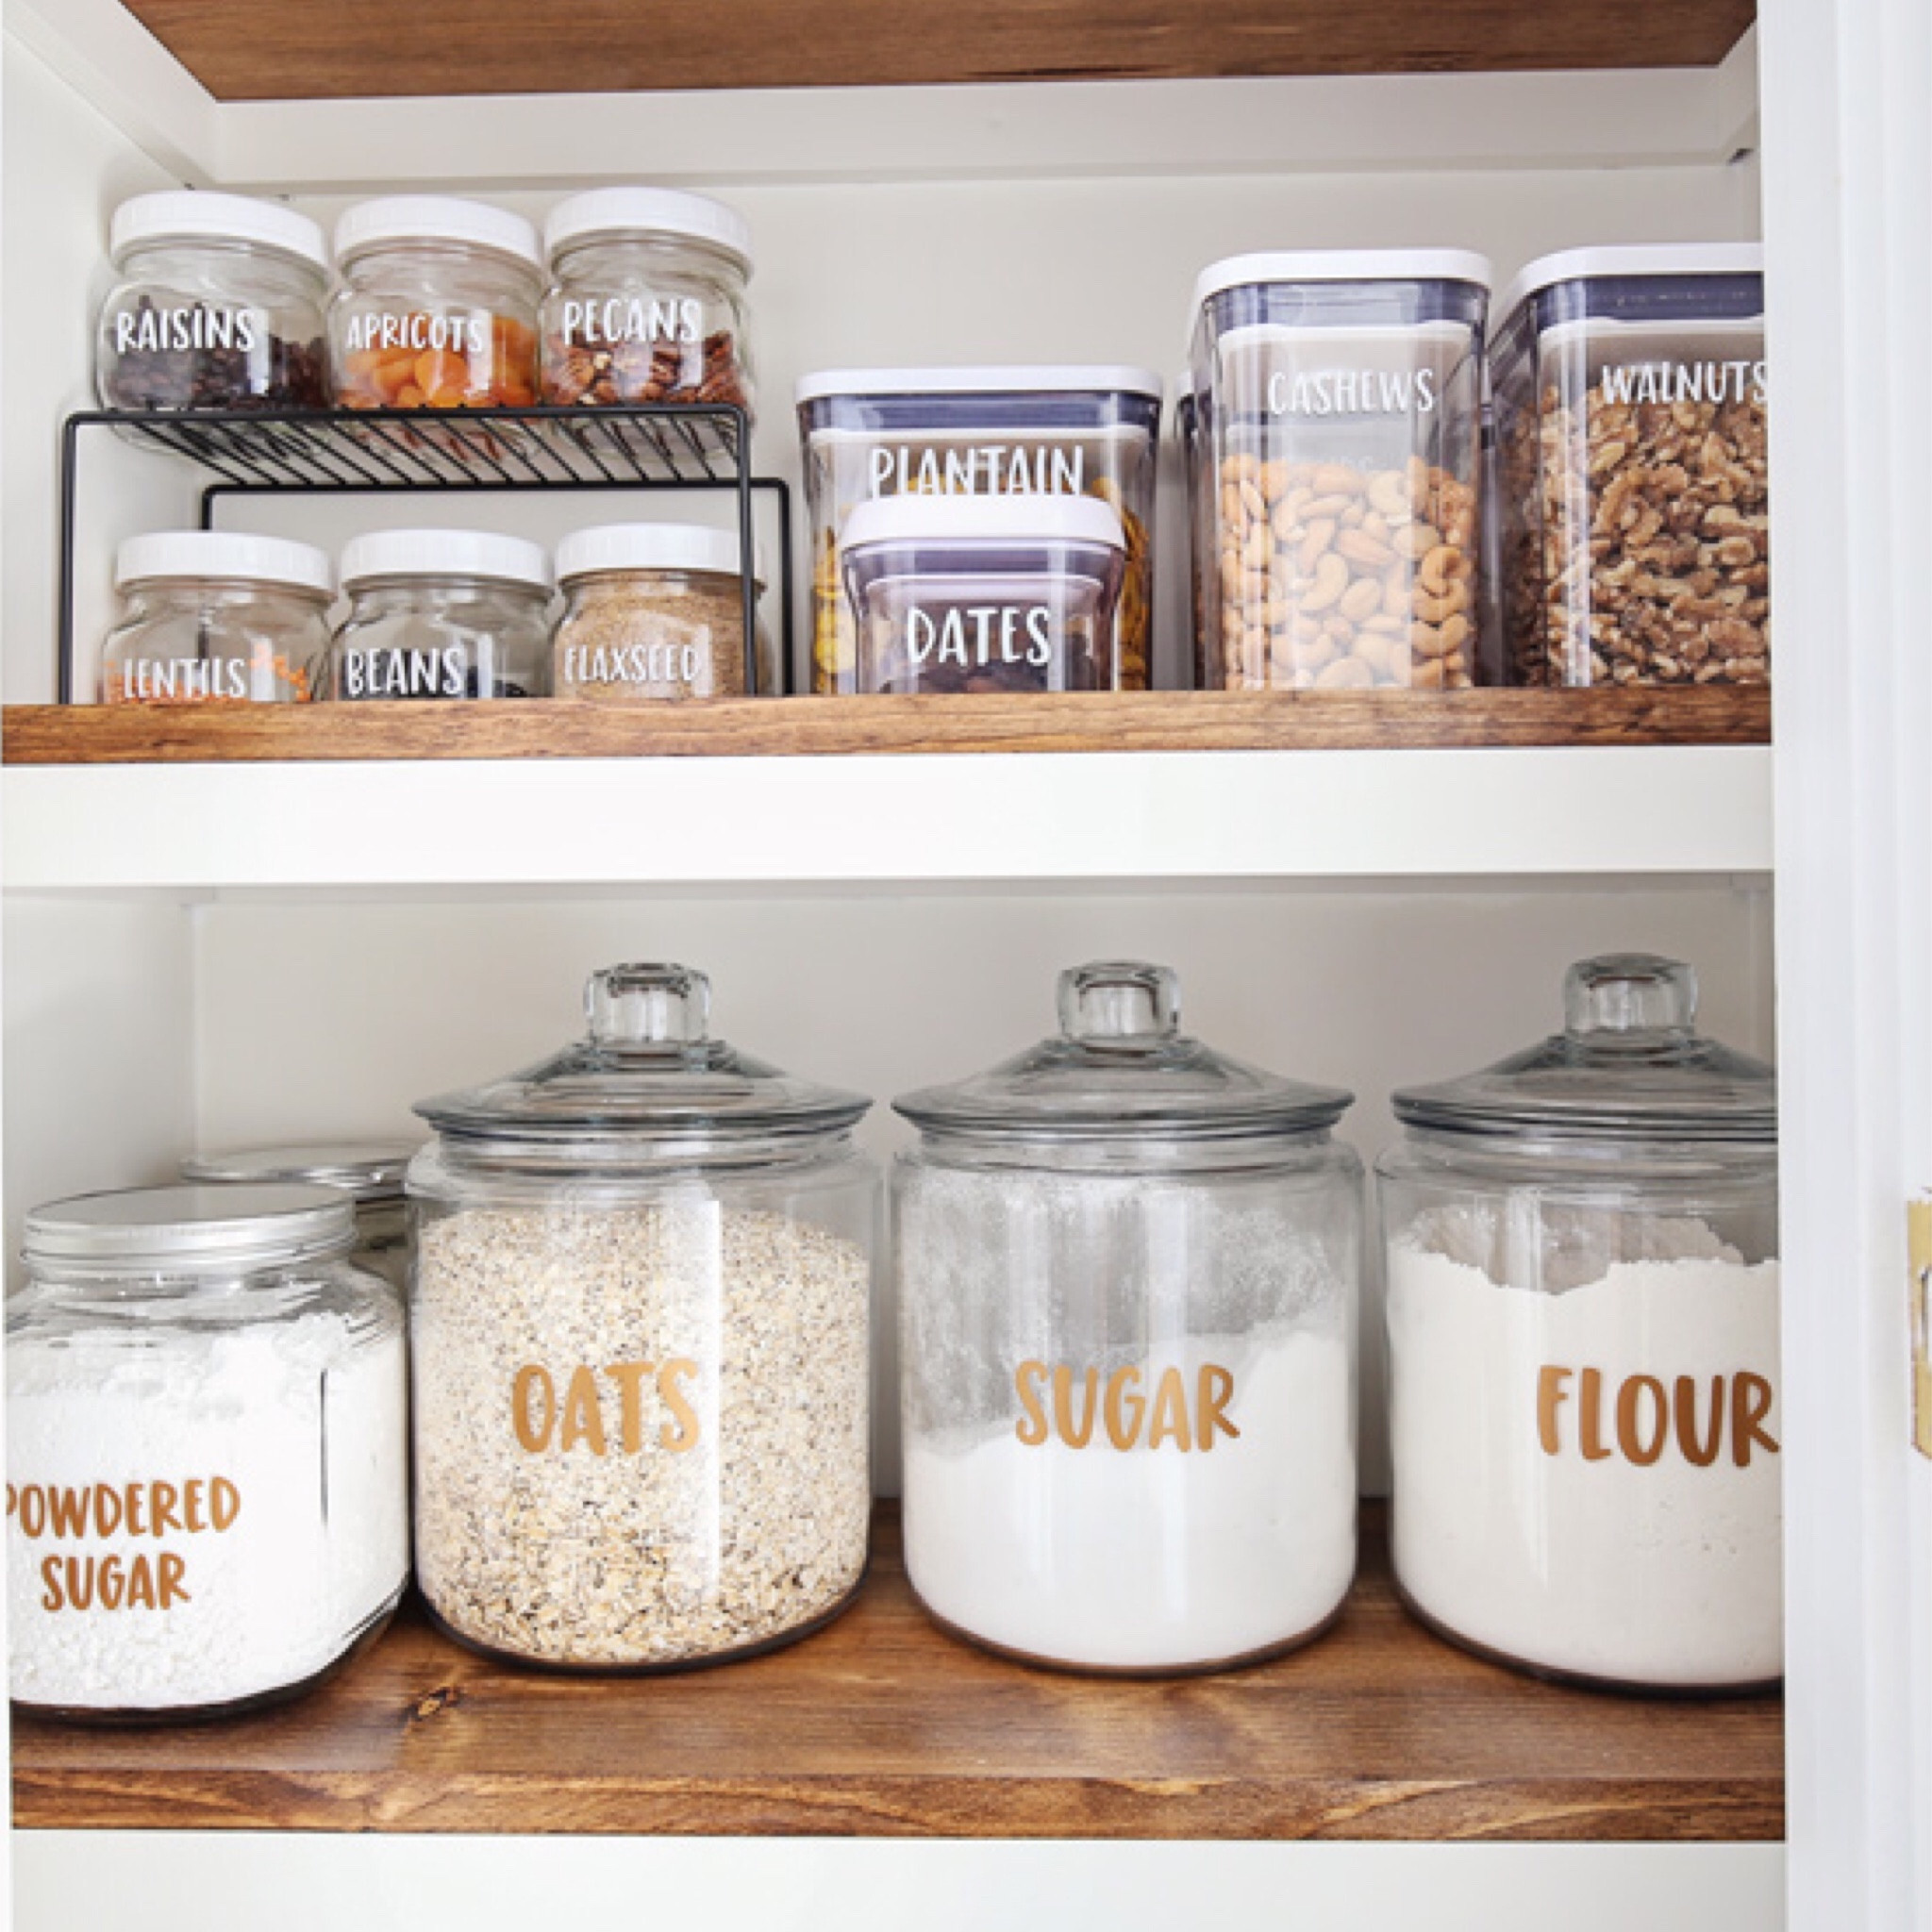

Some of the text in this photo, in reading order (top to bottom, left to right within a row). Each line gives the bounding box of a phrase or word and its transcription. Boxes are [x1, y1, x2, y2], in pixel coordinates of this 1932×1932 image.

[116, 308, 258, 354] RAISINS
[345, 313, 483, 352] APRICOTS
[564, 297, 703, 346] PECANS
[1268, 368, 1434, 414] CASHEWS
[1602, 360, 1768, 404] WALNUTS
[870, 445, 1084, 498] PLANTAIN
[907, 606, 1052, 666] DATES
[124, 657, 246, 699] LENTILS
[346, 646, 467, 696] BEANS
[564, 643, 699, 684] FLAXSEED
[511, 1358, 700, 1457] OATS
[1015, 1359, 1241, 1454] SUGAR
[1536, 1364, 1780, 1468] FLOUR
[41, 1551, 192, 1612] SUGAR
